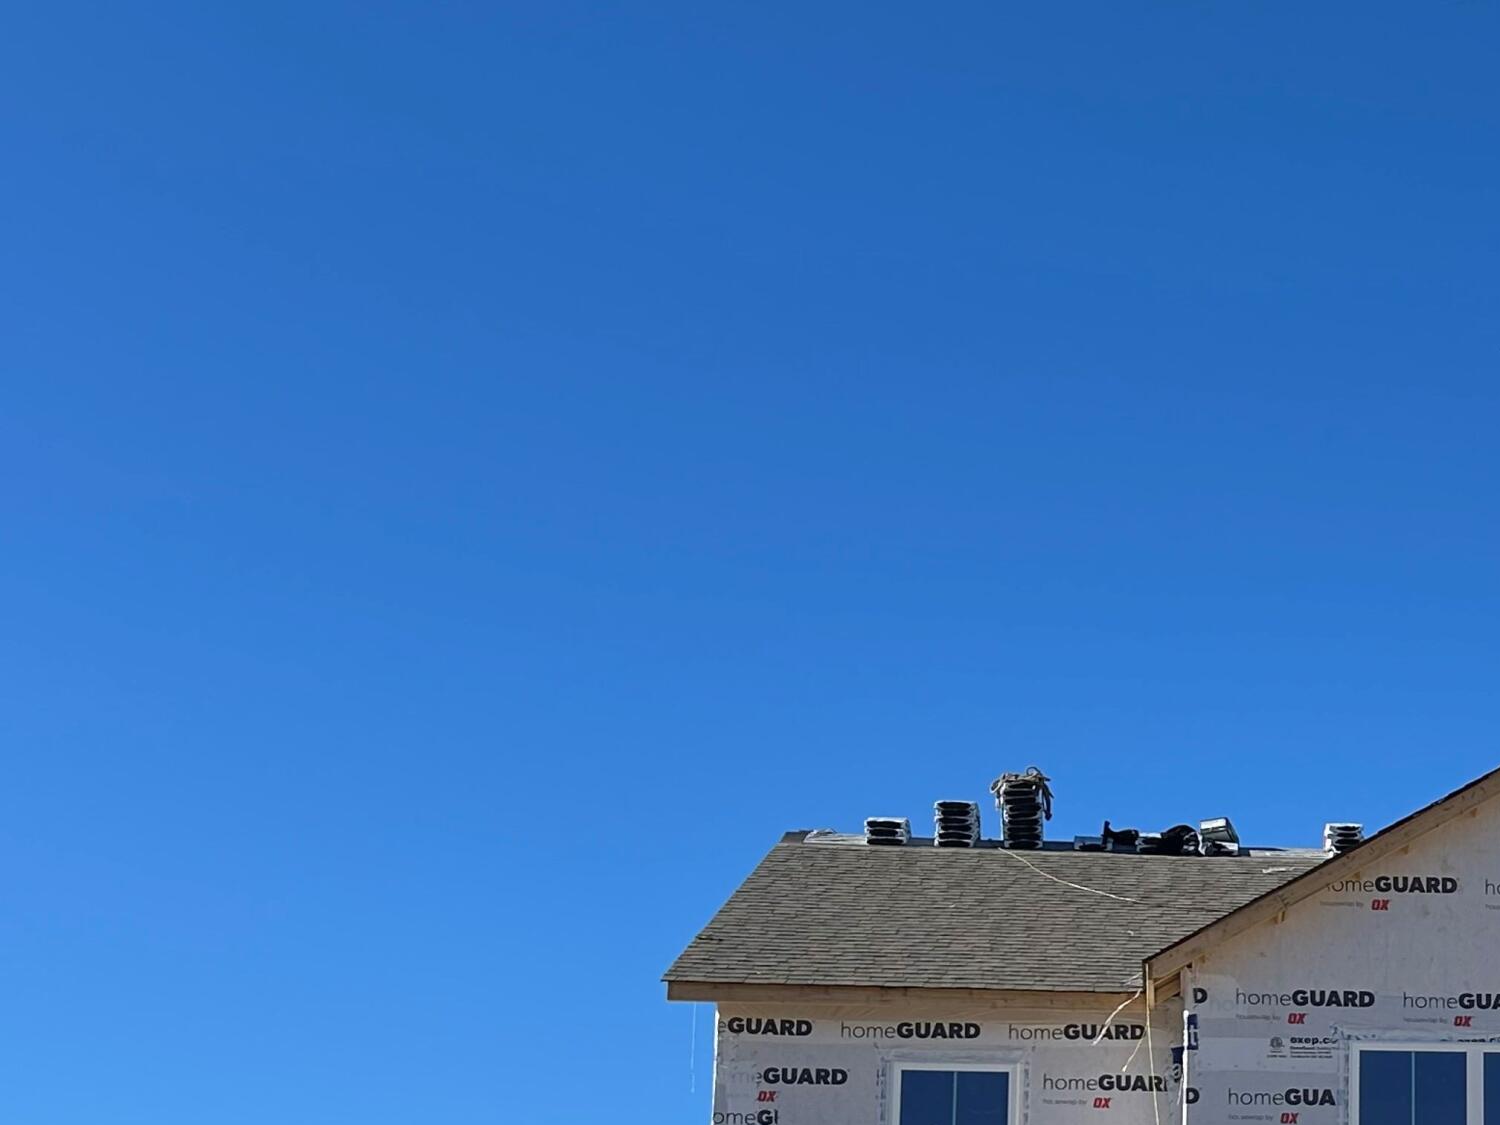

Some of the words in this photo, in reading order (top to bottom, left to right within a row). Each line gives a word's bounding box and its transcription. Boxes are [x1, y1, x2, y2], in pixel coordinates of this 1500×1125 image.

[1371, 899, 1389, 910] OX
[1236, 988, 1375, 1008] homeGUARD
[1287, 1013, 1307, 1024] OX
[1454, 1015, 1473, 1027] OX
[841, 1021, 981, 1041] homeGUARD
[1008, 1023, 1145, 1041] homeGUARD
[757, 1090, 777, 1103] OX
[1093, 1097, 1111, 1109] OX
[1280, 1112, 1299, 1124] OX
